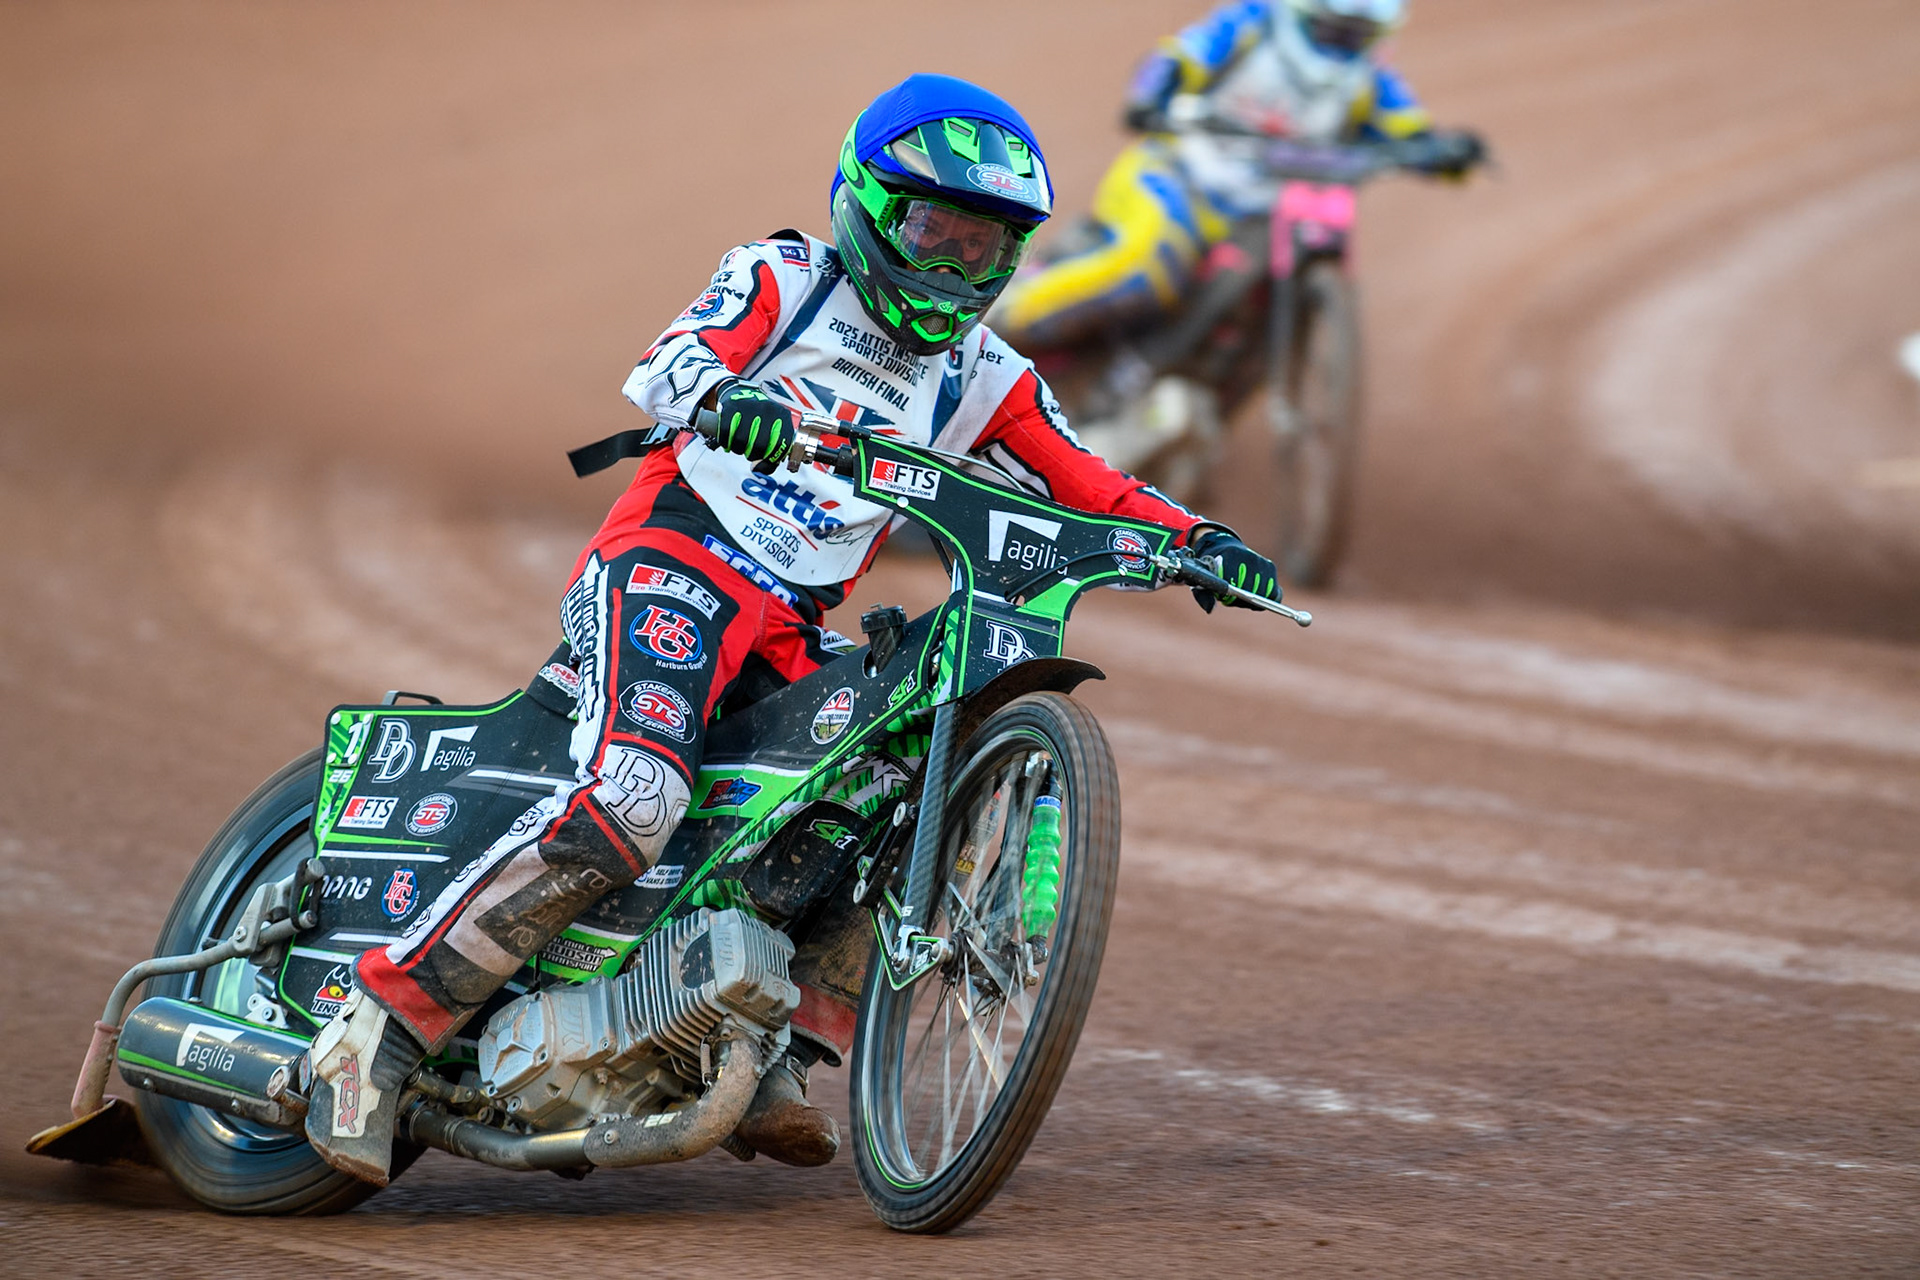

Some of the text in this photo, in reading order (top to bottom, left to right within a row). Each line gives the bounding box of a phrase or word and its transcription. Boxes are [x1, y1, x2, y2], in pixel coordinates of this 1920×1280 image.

[982, 171, 1023, 190] STS
[828, 317, 860, 339] 2025
[860, 331, 892, 356] ATTIS
[841, 337, 884, 367] SPORTS
[831, 357, 911, 412] BRITISH FINAL
[872, 479, 932, 497] Fire Training Services
[894, 464, 936, 490] FTS
[742, 472, 845, 540] attis
[740, 525, 796, 570] DIVISION
[753, 517, 802, 554] SPORTS
[1114, 529, 1147, 548] STAKEFORD
[1007, 539, 1069, 576] agilia
[648, 585, 678, 597] Training
[662, 572, 715, 611] FTS
[634, 604, 697, 661] HG
[655, 659, 689, 671] Hartburn
[634, 682, 691, 716] STAKEFORD
[635, 693, 682, 728] STS
[344, 722, 363, 758] 1
[644, 719, 685, 740] SERVICES
[434, 746, 476, 771] agilia
[328, 769, 354, 783] 26
[360, 799, 395, 819] FTS
[413, 807, 449, 821] STS
[384, 870, 414, 914] HG
[546, 942, 603, 966] HUDSON
[312, 999, 341, 1015] TENG
[188, 1044, 236, 1073] agilia
[338, 1053, 360, 1134] TCX
